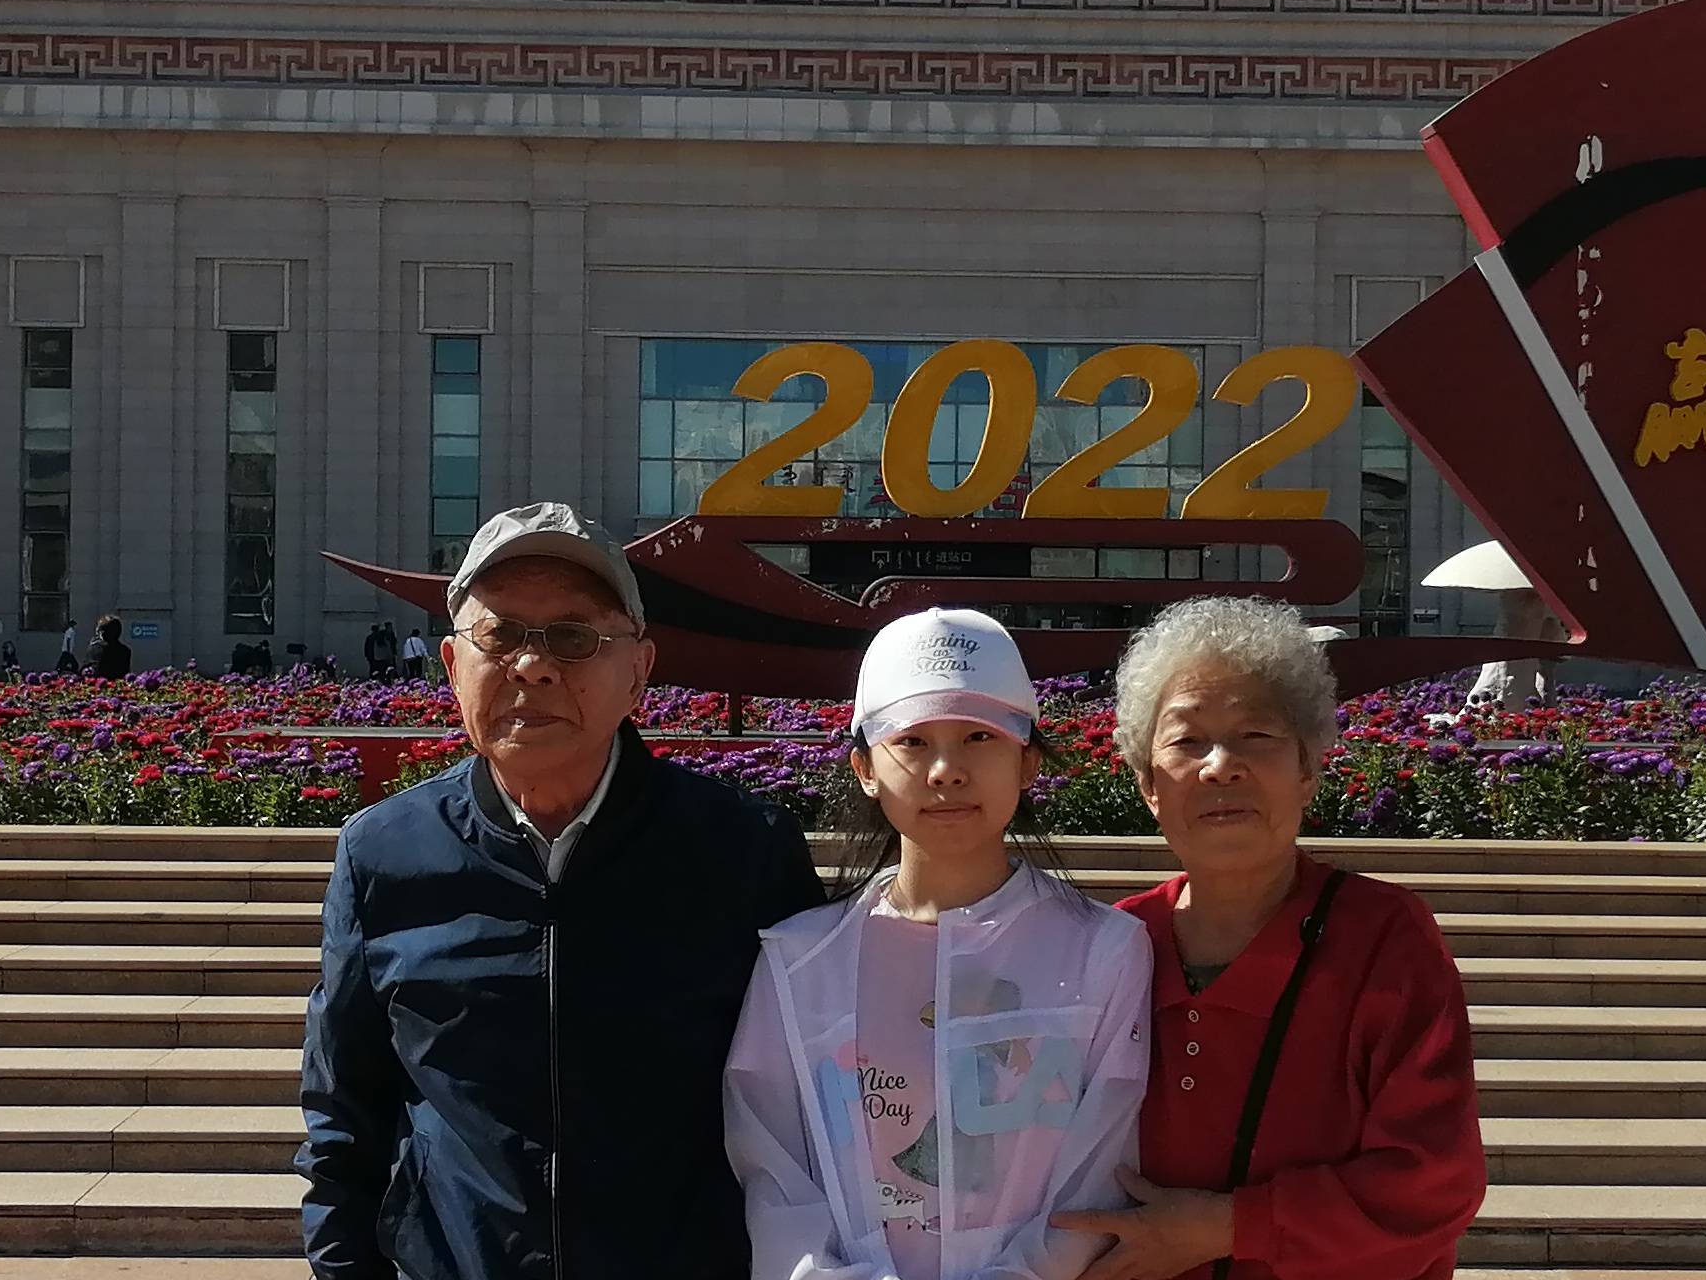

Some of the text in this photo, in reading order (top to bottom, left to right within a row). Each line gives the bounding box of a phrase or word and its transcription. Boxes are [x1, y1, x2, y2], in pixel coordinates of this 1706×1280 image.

[698, 339, 1358, 518] 2022
[857, 1067, 908, 1090] Nice
[863, 1093, 913, 1126] Day
